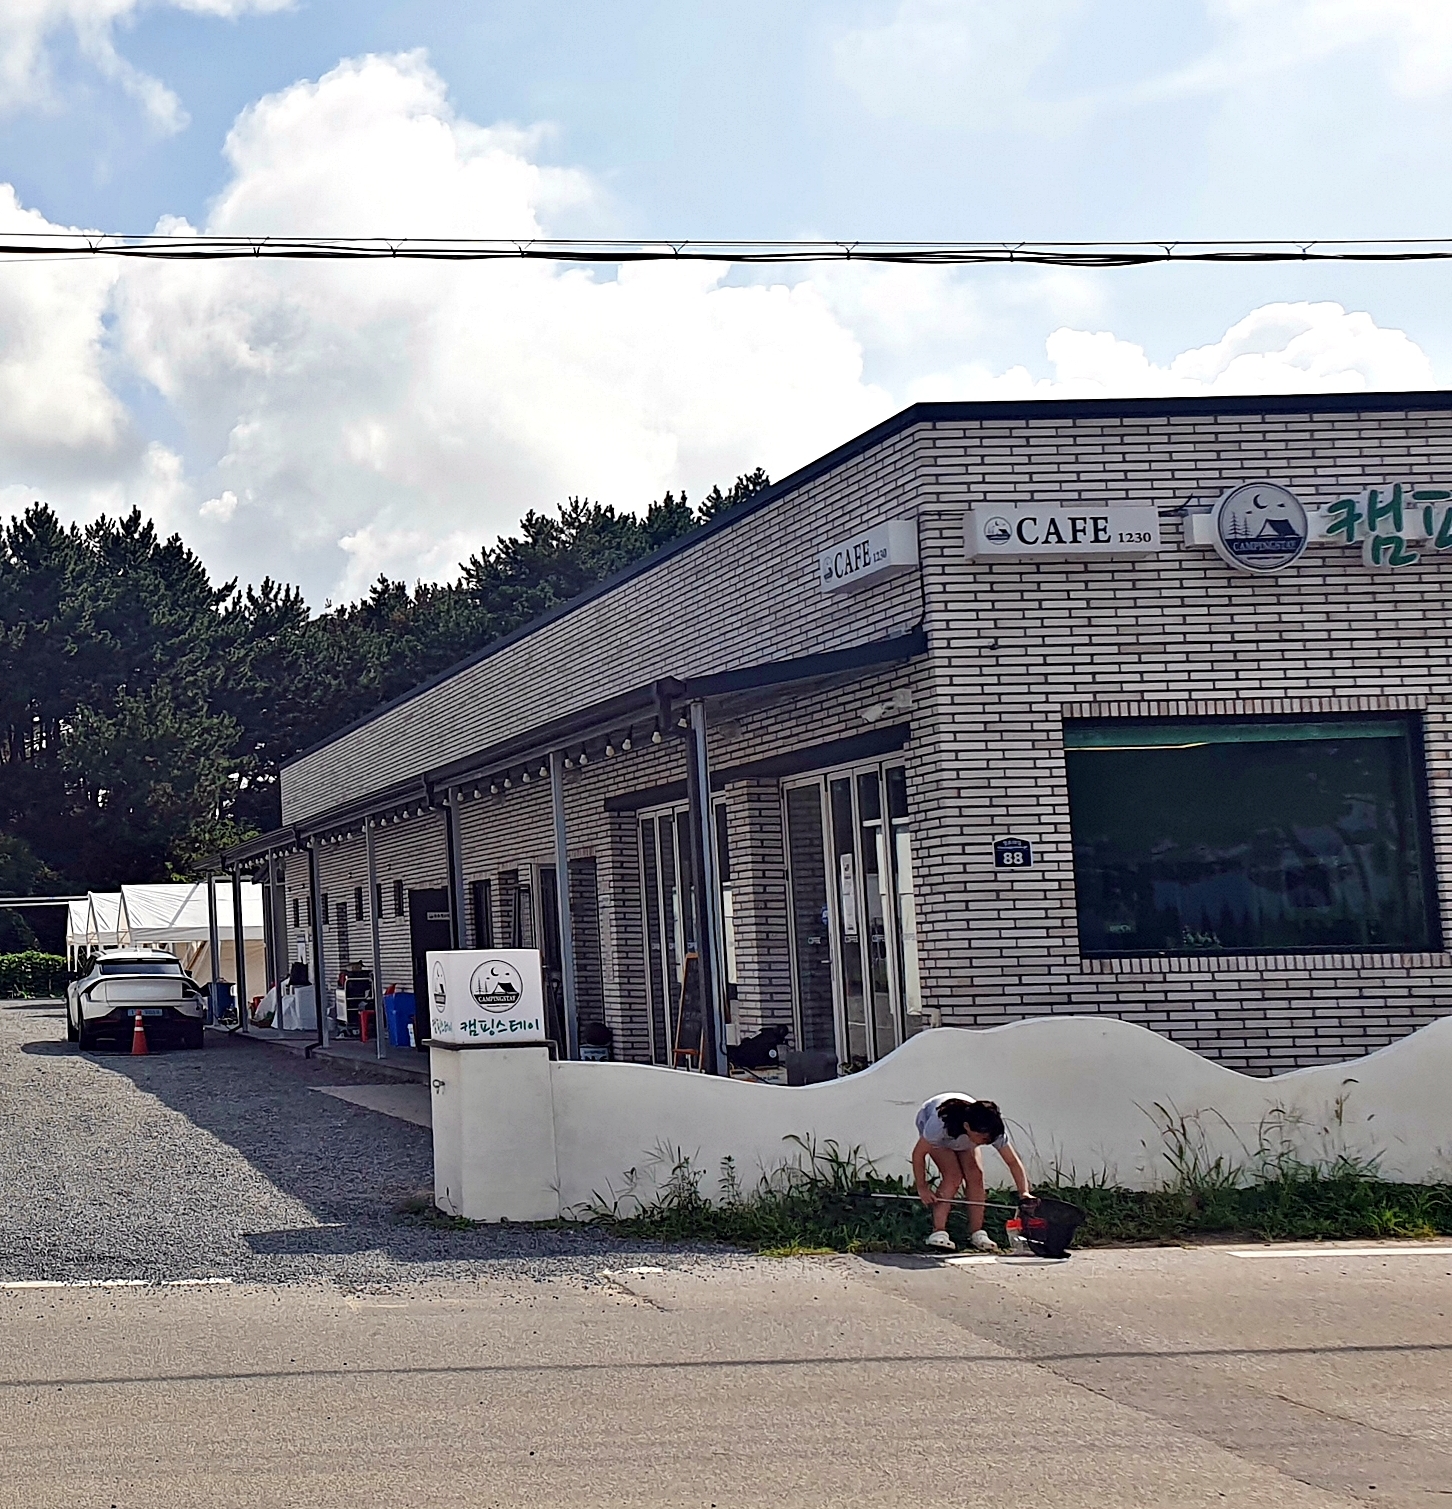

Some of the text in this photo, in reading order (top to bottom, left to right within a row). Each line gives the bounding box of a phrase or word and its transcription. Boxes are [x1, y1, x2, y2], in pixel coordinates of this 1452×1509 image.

[1016, 516, 1152, 546] CAFE 1230
[834, 540, 888, 579] CAFE 1230
[1003, 852, 1024, 865] 88
[459, 1018, 540, 1037] 캠핑스테이
